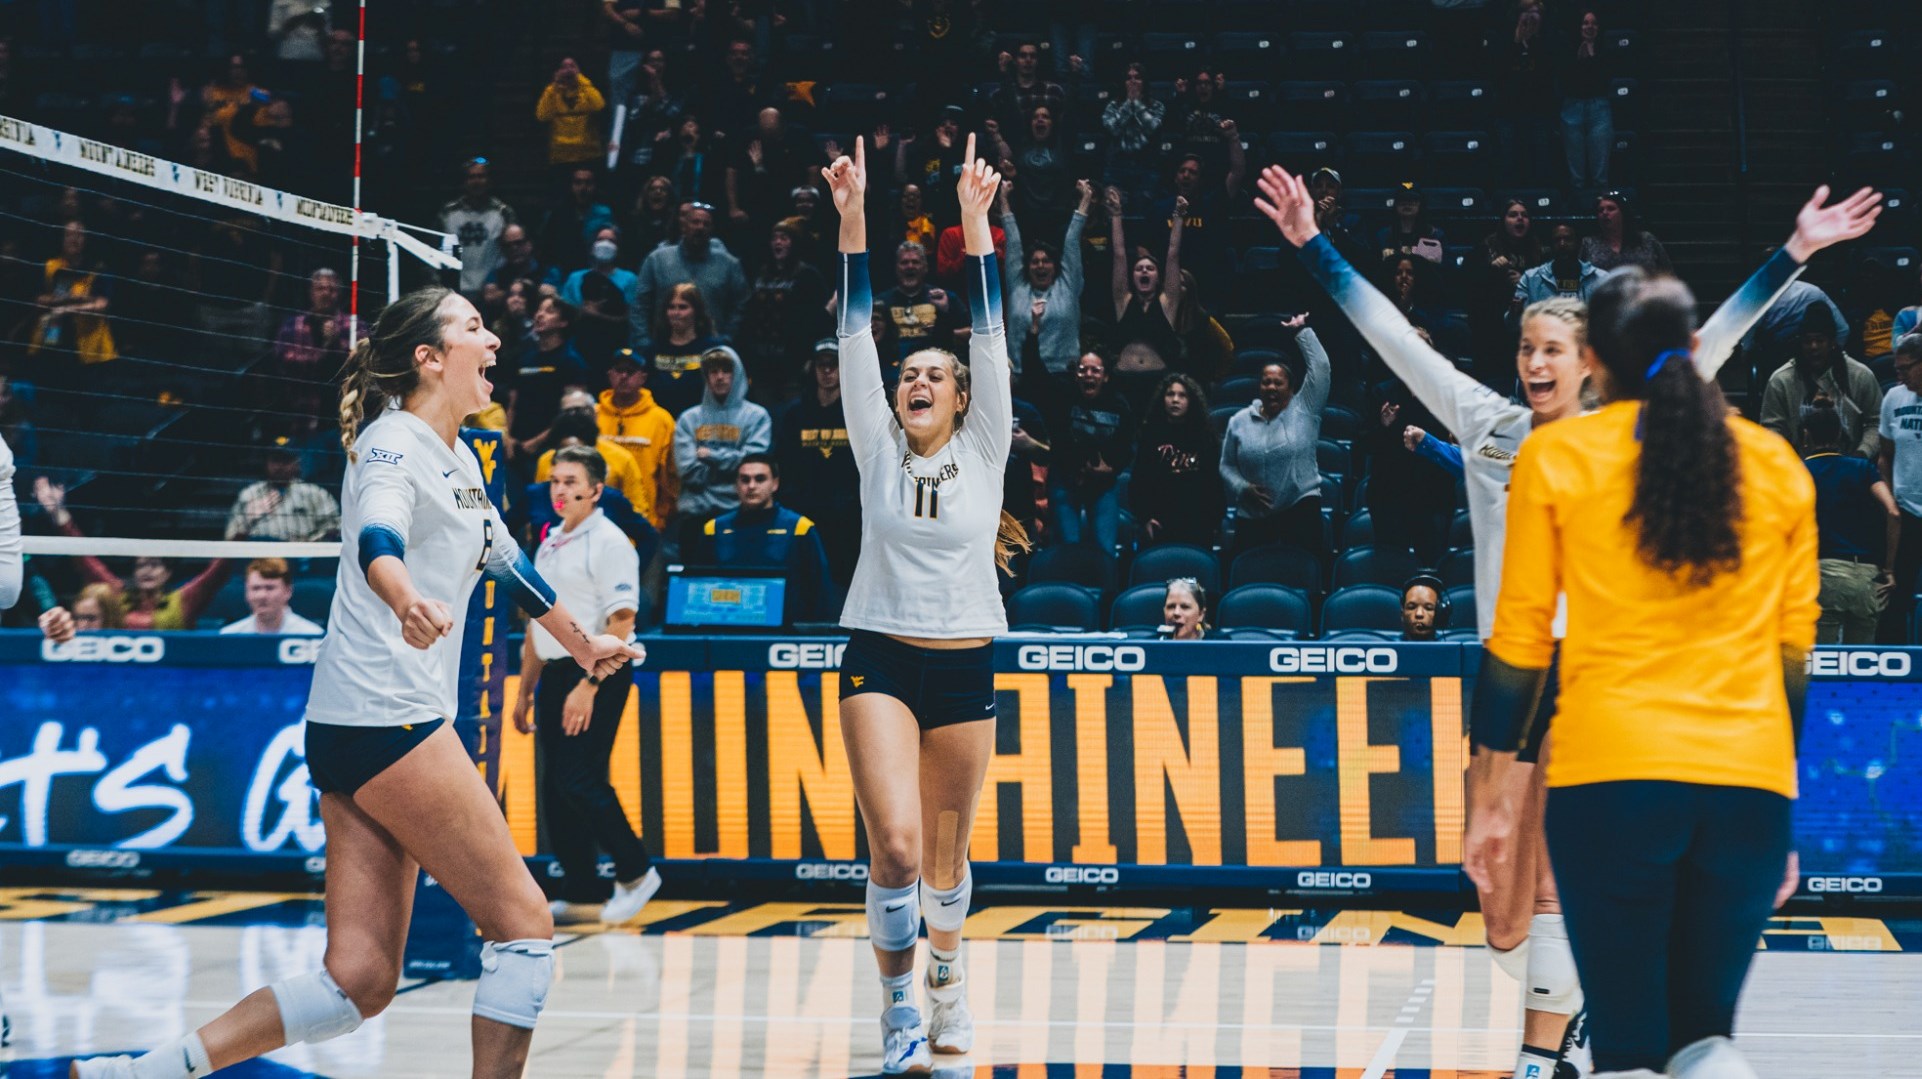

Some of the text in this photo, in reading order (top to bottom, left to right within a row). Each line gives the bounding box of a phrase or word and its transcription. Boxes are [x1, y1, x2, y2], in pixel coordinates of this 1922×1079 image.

[914, 477, 939, 519] 11
[42, 637, 165, 662] GEICO
[769, 643, 847, 669] GEI
[1018, 645, 1146, 672] GEICO
[1269, 646, 1398, 673] GEICO
[1804, 651, 1911, 677] EICO
[66, 850, 141, 868] GEICO
[796, 863, 869, 879] GEICO
[1045, 867, 1119, 883] GEICO
[1297, 872, 1371, 888] GEICO
[1808, 877, 1882, 892] GEICO
